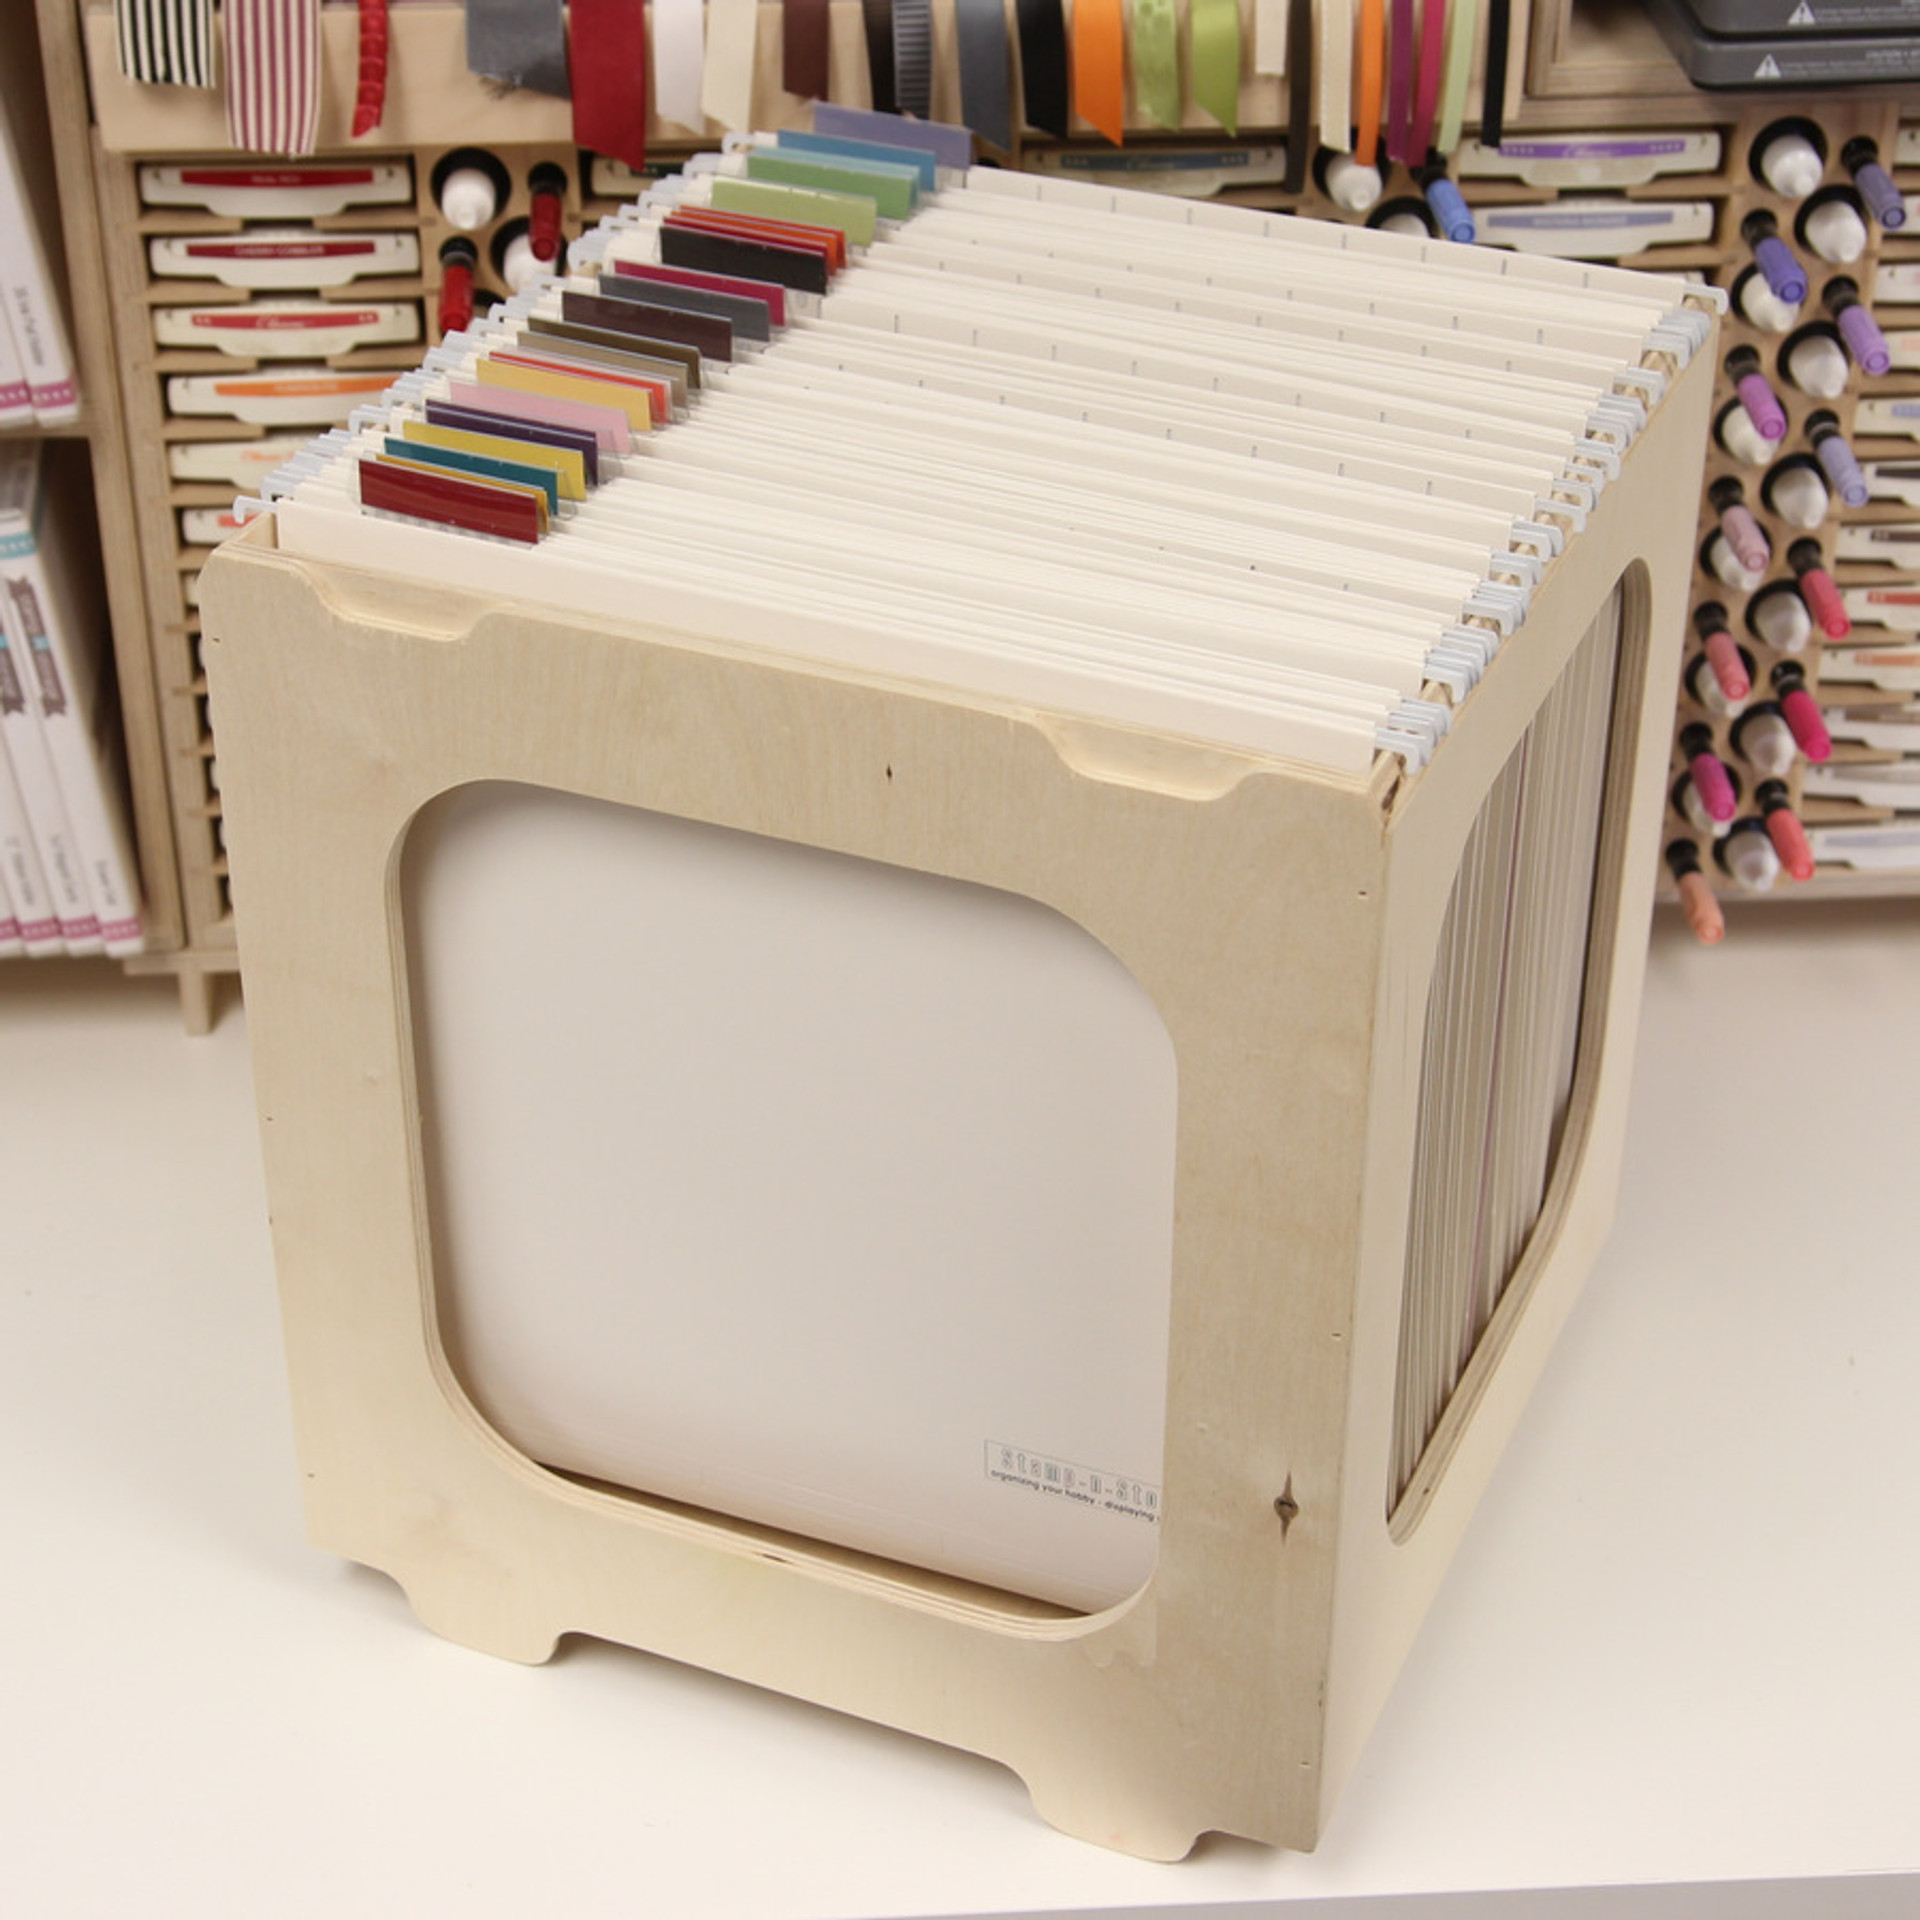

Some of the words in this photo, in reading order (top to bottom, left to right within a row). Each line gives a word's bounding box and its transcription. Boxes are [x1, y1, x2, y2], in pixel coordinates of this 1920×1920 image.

[990, 1470, 1040, 1491] organizing
[1041, 1484, 1064, 1495] your
[1064, 1489, 1096, 1505] hobby
[1104, 1501, 1156, 1523] displaying
